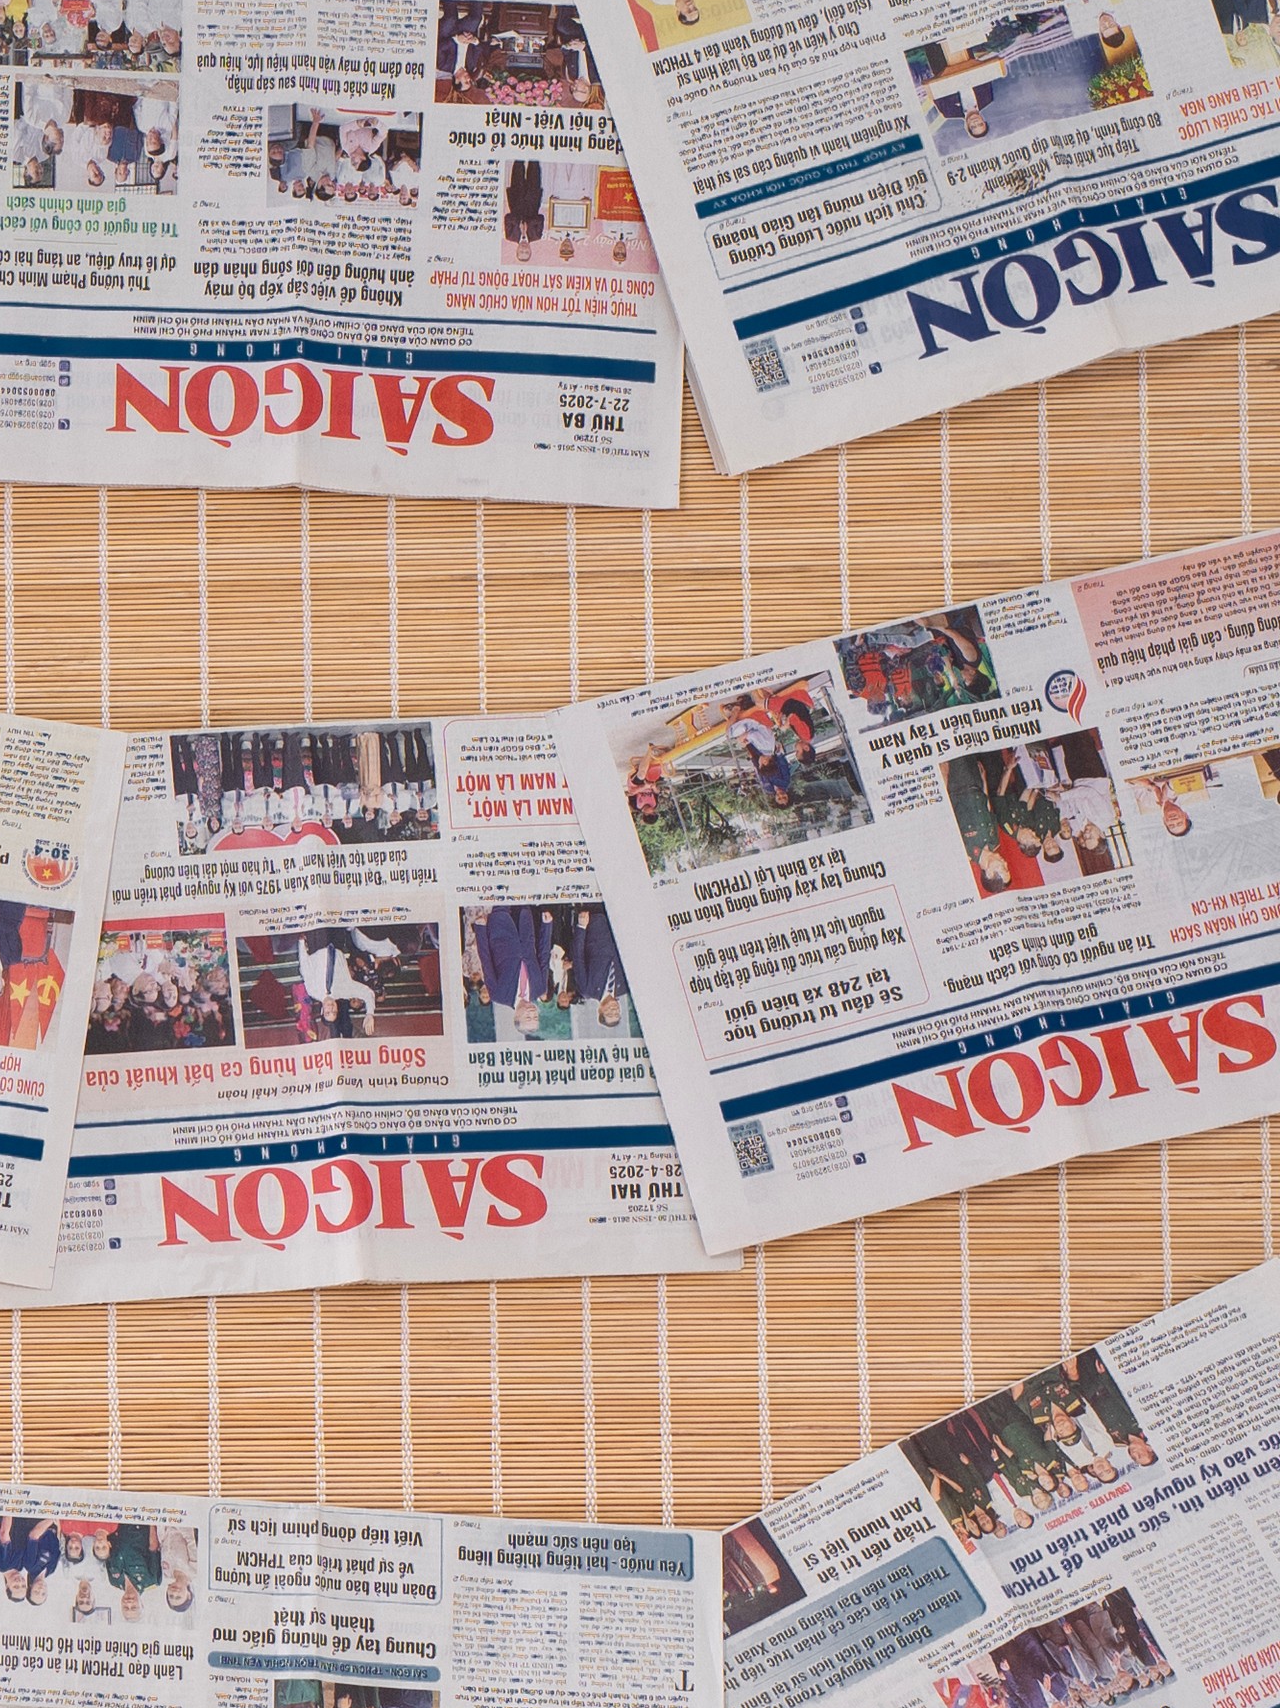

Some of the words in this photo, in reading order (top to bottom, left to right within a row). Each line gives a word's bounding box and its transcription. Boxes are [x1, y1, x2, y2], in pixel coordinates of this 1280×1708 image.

[562, 412, 585, 428] BA
[590, 413, 624, 431] THỨ
[249, 1056, 296, 1077] hùng
[302, 1050, 332, 1074] bản
[339, 1049, 371, 1068] mãi
[378, 1044, 426, 1070] Sống
[125, 1065, 178, 1090] khuất
[183, 1063, 214, 1086] bất
[220, 1061, 242, 1077] ca
[85, 1069, 119, 1092] của
[610, 1183, 641, 1199] HAI
[647, 1181, 683, 1202] THỨ
